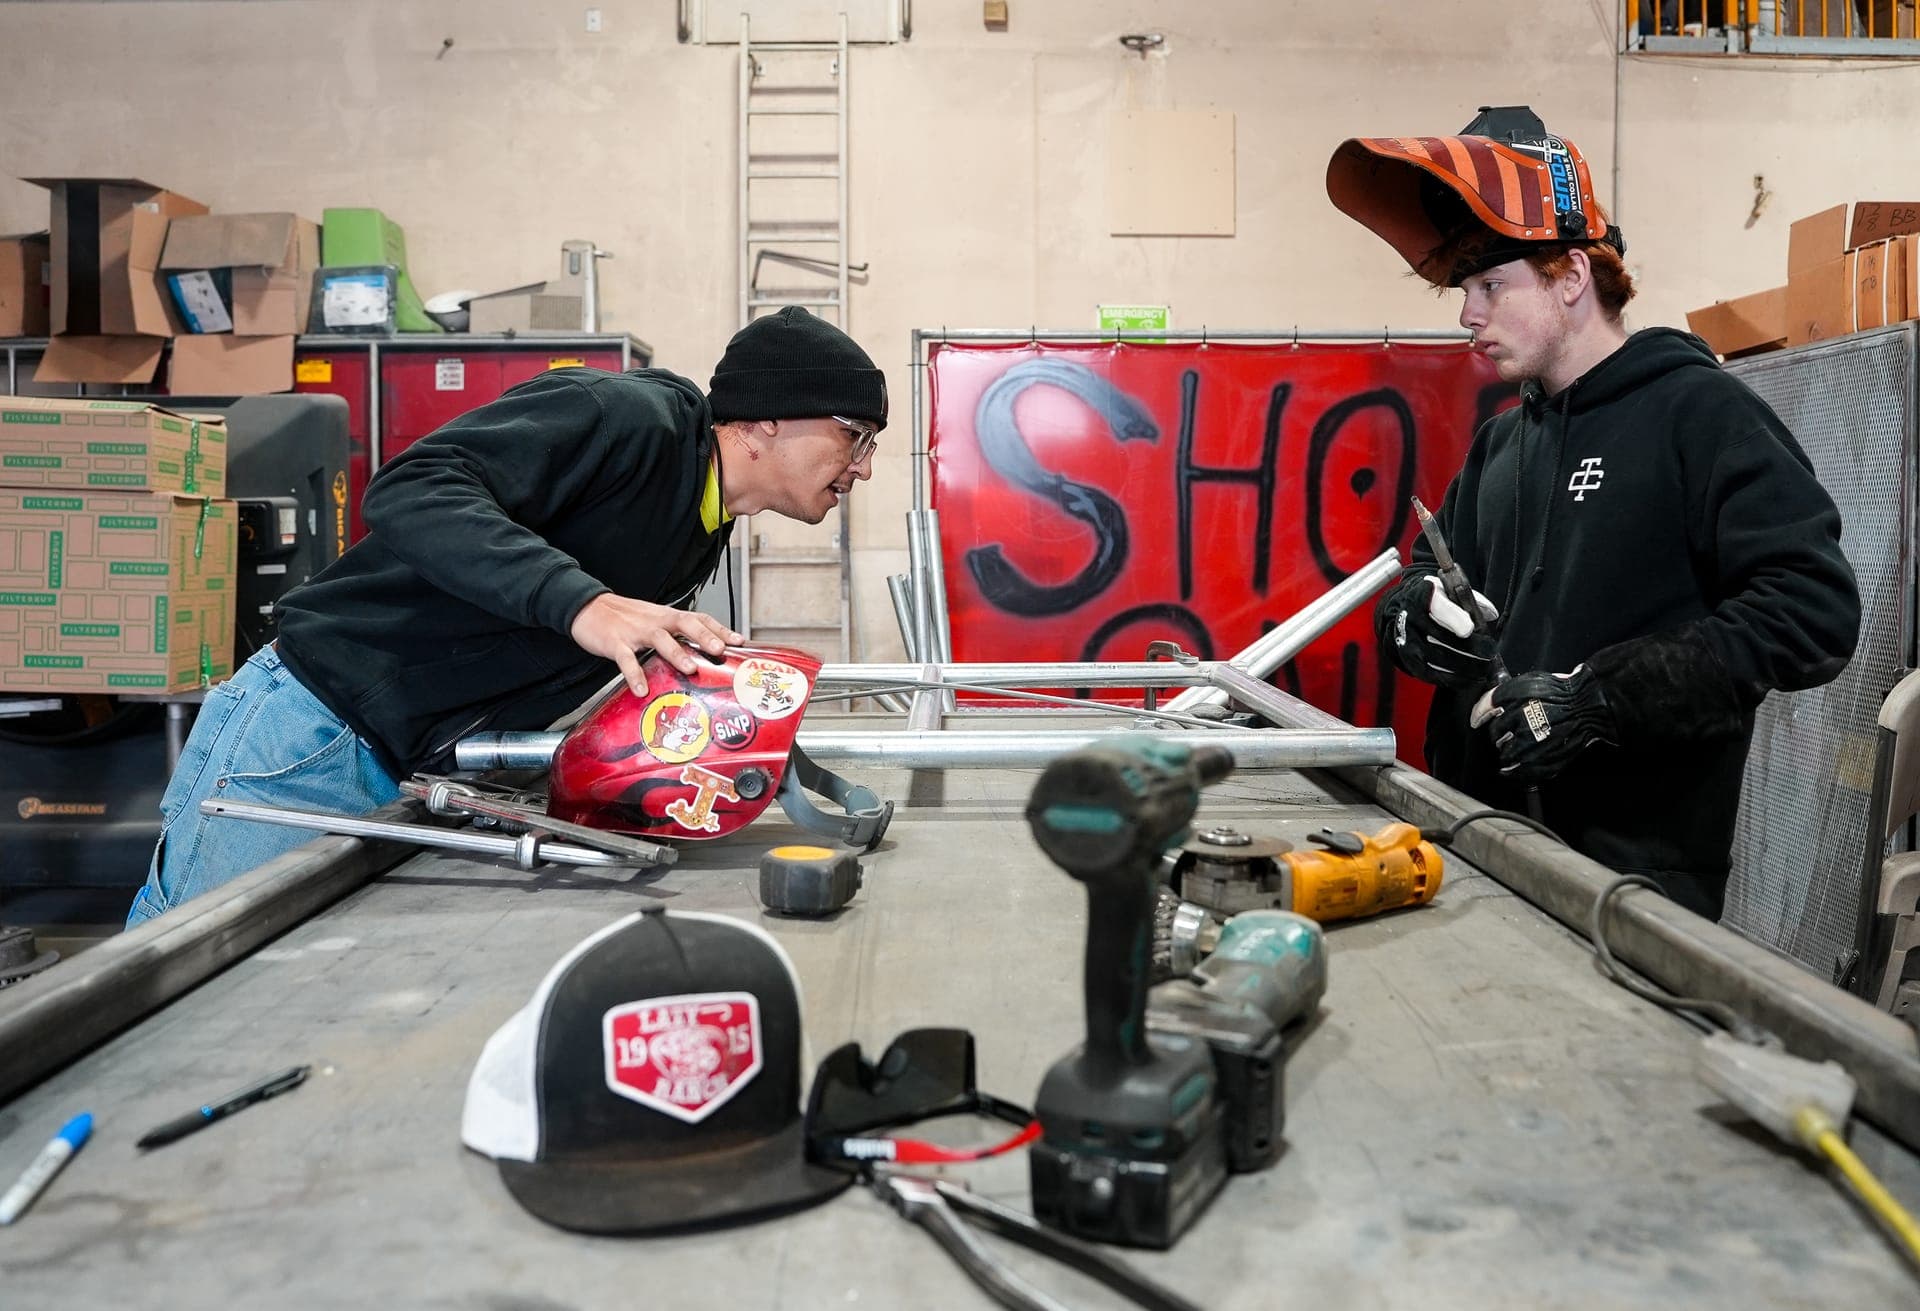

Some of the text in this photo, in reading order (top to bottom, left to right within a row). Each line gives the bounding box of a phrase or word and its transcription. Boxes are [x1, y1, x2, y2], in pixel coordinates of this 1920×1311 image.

[1565, 163, 1574, 181] BLUE
[1568, 182, 1578, 211] COLLAR
[1103, 308, 1164, 319] EMERGENCY
[26, 499, 80, 508] FILTERBUY
[101, 518, 155, 527] FILTERBUY
[112, 564, 166, 573] FILTERBUY
[63, 626, 117, 635] FILTERBUY
[27, 658, 81, 666] FILTERBUY
[747, 660, 797, 674] ACAB
[110, 676, 164, 685] FILTERBUY
[715, 714, 750, 740] SIMP
[616, 1023, 750, 1068] 19 15
